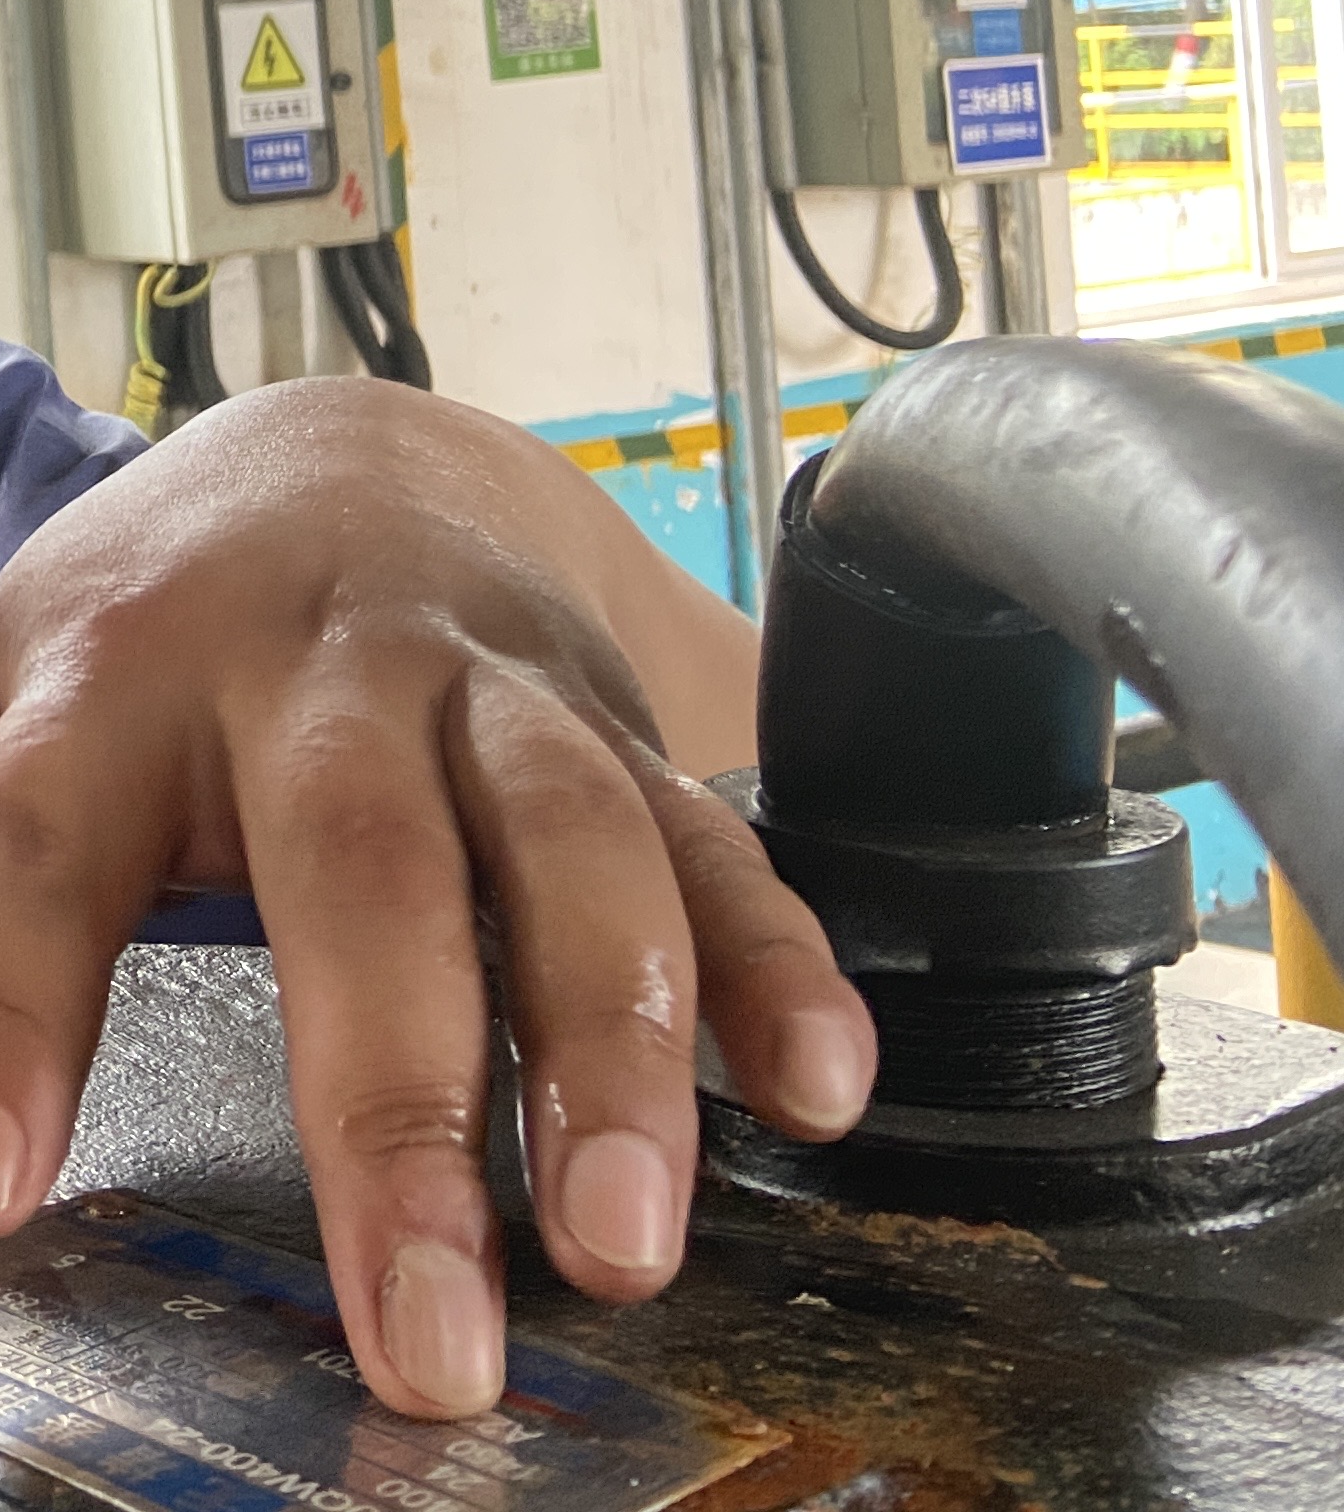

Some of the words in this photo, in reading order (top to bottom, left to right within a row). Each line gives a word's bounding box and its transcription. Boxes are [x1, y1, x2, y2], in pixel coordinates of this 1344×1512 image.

[50, 1253, 86, 1269] 5
[162, 1293, 226, 1321] 22
[148, 1418, 379, 1512] QW400-24
[424, 1461, 488, 1492] 24
